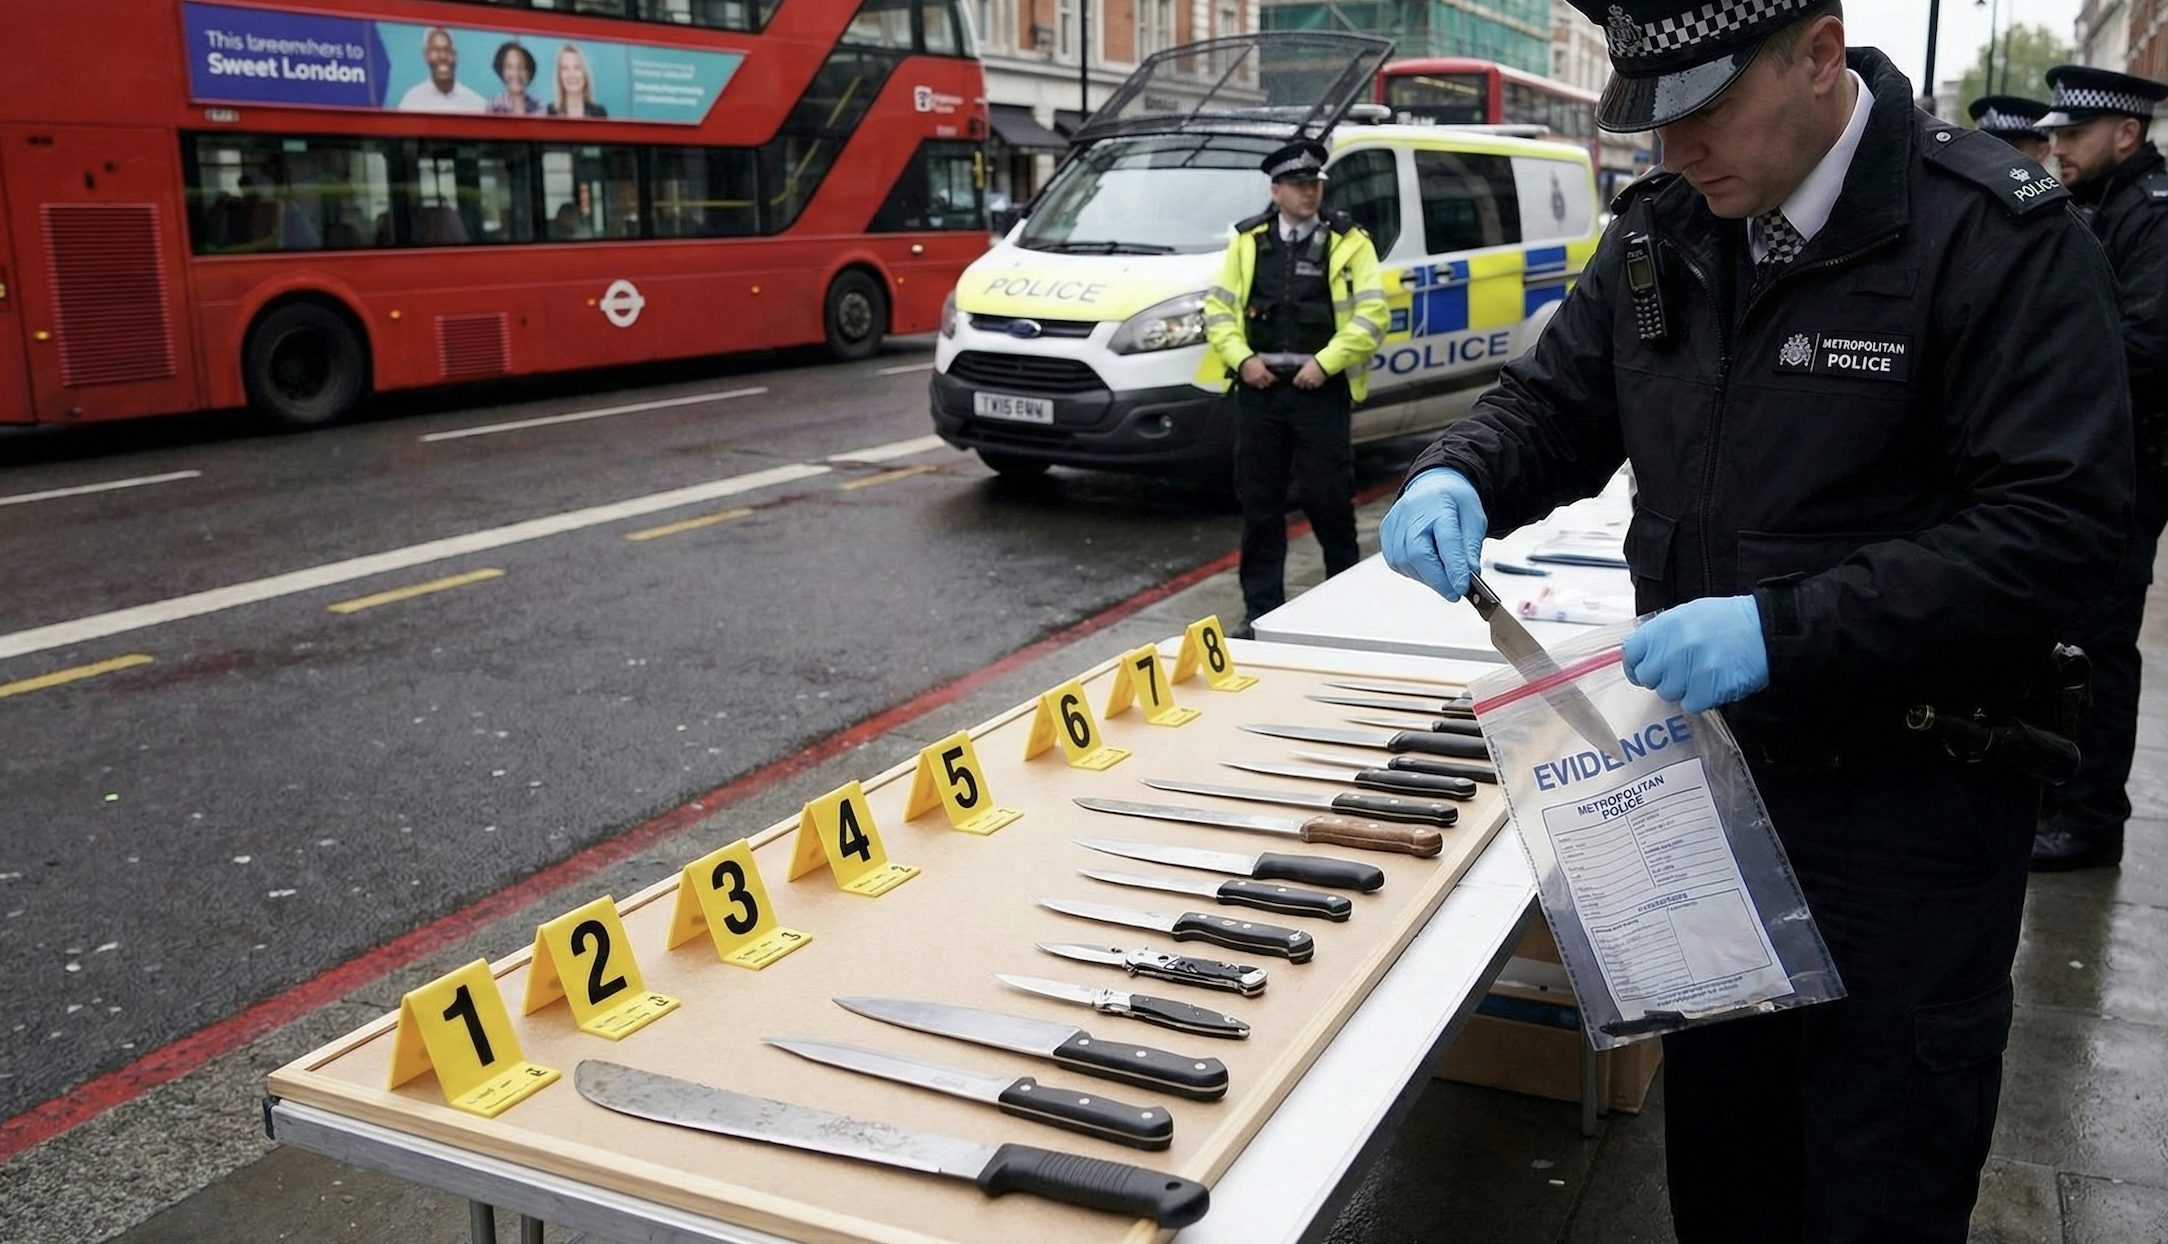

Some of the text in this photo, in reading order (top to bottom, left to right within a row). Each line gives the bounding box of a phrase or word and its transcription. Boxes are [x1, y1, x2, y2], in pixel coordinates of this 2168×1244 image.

[205, 29, 244, 50] This
[346, 43, 364, 60] to
[207, 52, 366, 83] Sweet London
[2013, 177, 2060, 201] POLICE
[984, 278, 1106, 303] POLICE
[1822, 338, 1905, 355] METROPOLITAN
[1827, 353, 1892, 373] POLICE
[1202, 627, 1225, 673] 8
[1136, 655, 1159, 707] 7
[1060, 694, 1090, 748] 6
[1533, 714, 1693, 791] EVIDENCE
[941, 745, 978, 809] 5
[1577, 775, 1665, 816] METROPOLITAN
[839, 798, 870, 862] 4
[1602, 795, 1645, 820] POLICE
[711, 860, 759, 935] 3
[570, 919, 628, 1006] 2
[442, 983, 495, 1067] 1
